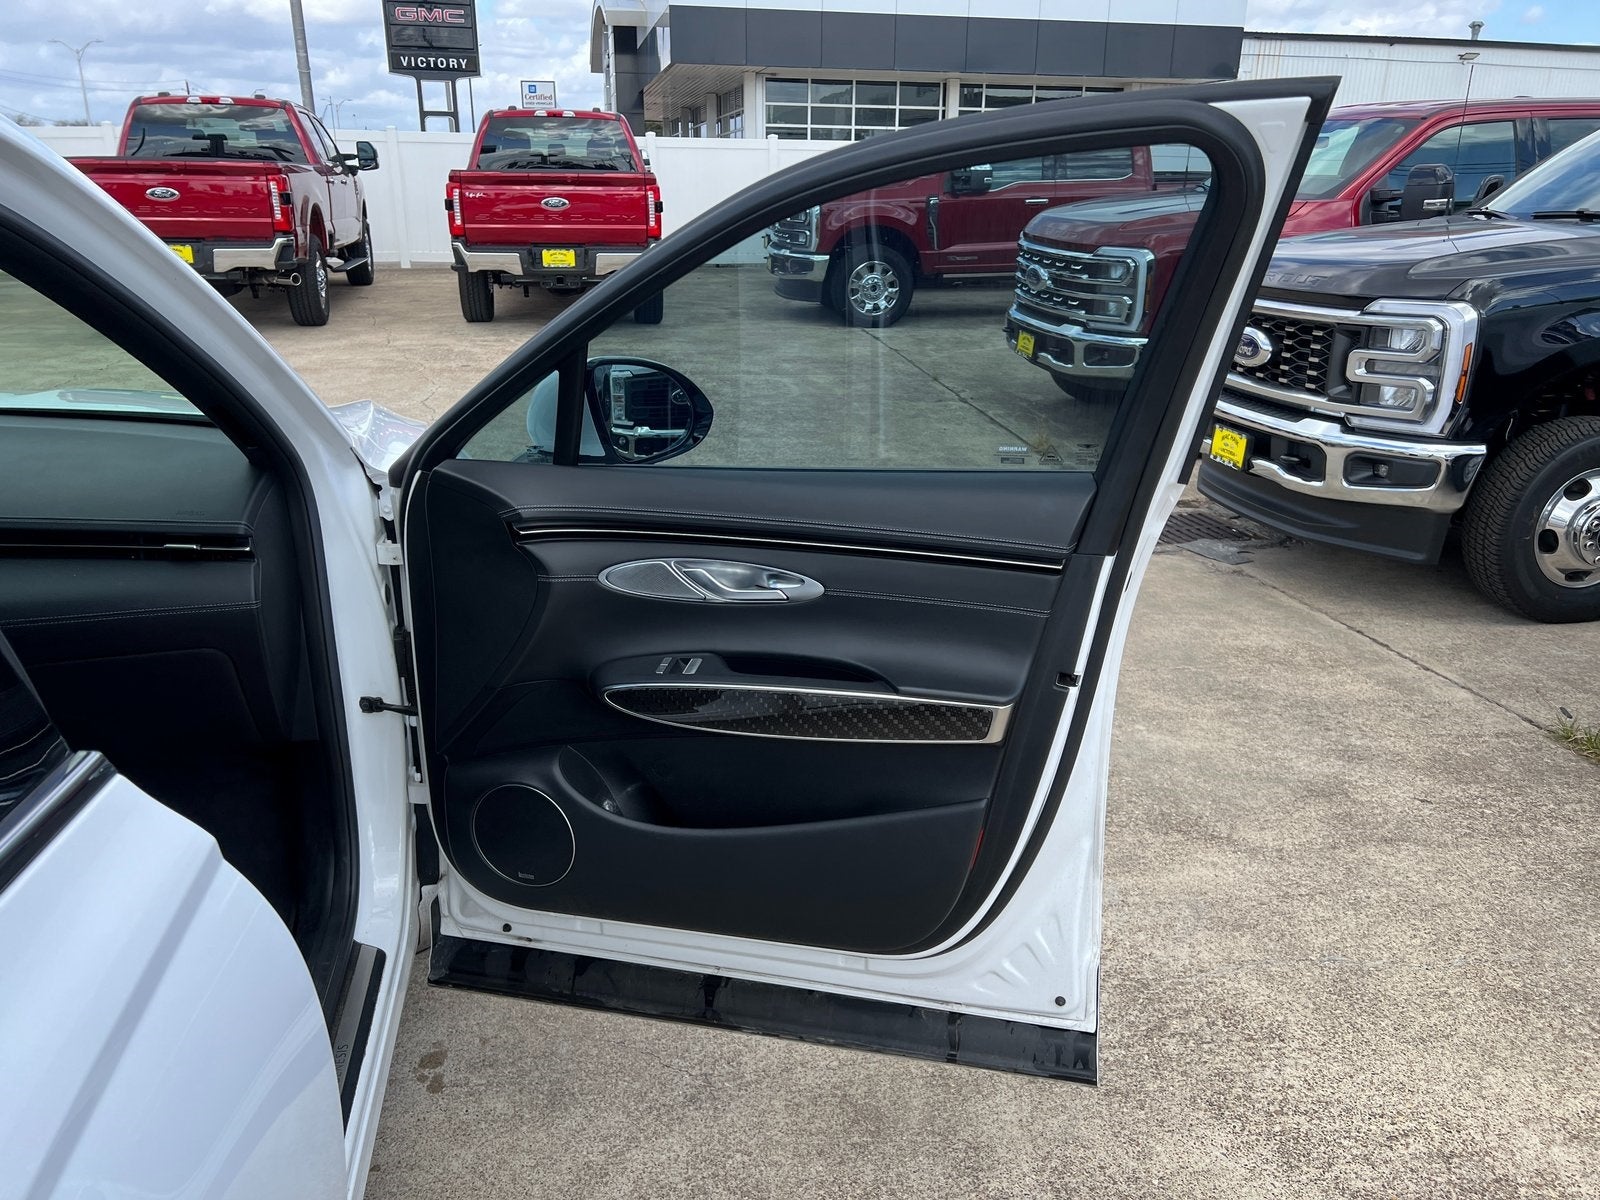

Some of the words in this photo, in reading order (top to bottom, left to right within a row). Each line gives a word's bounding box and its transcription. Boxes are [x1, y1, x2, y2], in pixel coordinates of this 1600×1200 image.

[395, 7, 464, 23] GMC
[400, 56, 467, 69] VICTORY
[335, 1044, 349, 1081] ENESIS
